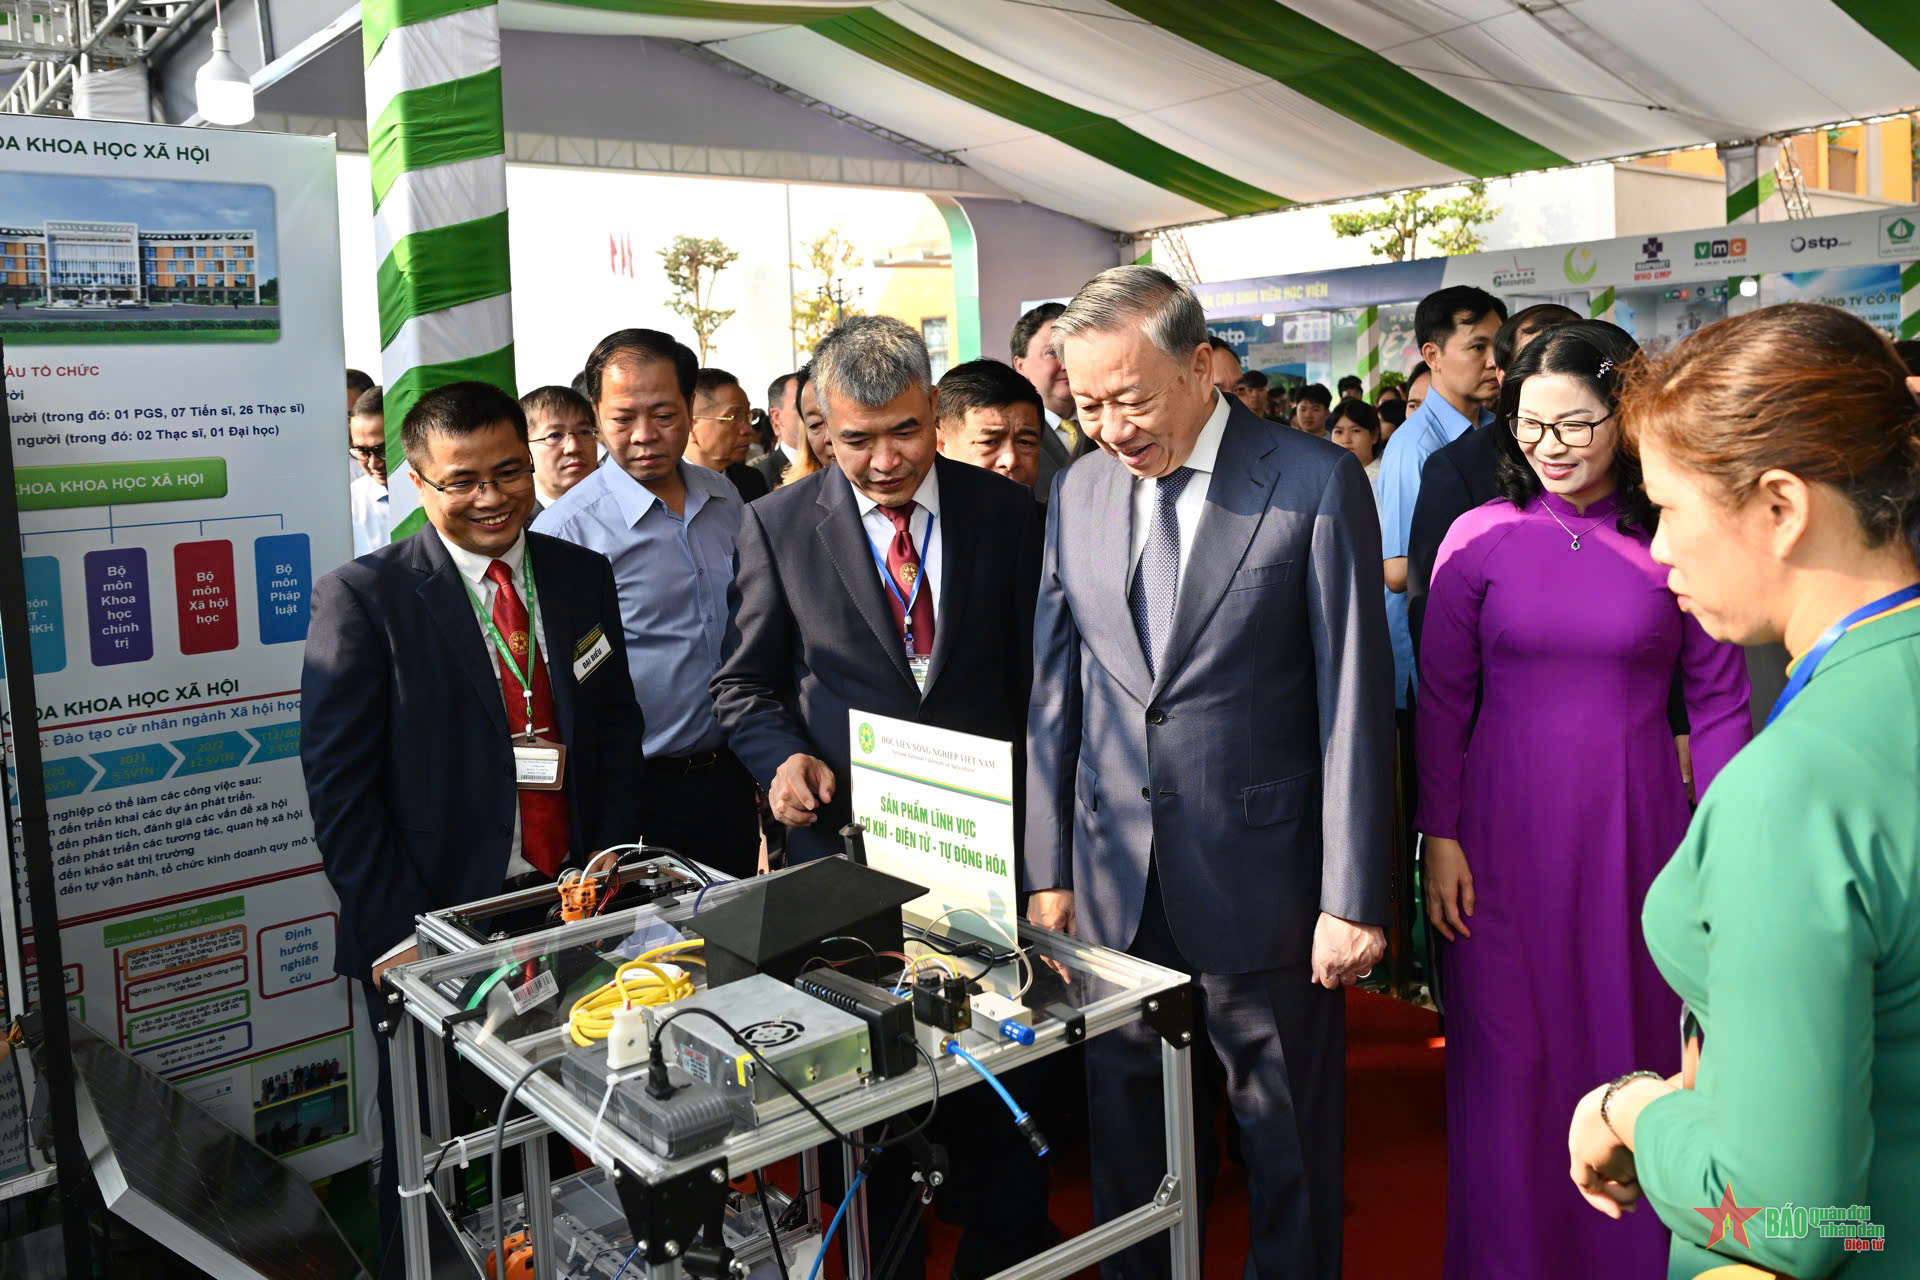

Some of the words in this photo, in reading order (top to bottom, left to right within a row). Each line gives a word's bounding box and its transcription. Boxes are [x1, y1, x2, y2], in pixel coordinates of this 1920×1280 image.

[26, 136, 87, 155] KHOA
[93, 141, 137, 160] HỌC
[143, 142, 170, 159] XÃ
[176, 146, 209, 164] HỘI
[1697, 240, 1744, 257] vmc
[1807, 236, 1838, 250] stp
[1633, 272, 1652, 281] WHO
[1654, 271, 1672, 279] GMP
[1849, 296, 1862, 305] TY
[1217, 328, 1245, 346] stp
[56, 363, 100, 377] CHỨC
[42, 412, 83, 424] (trong
[88, 410, 110, 420] đó:
[114, 410, 129, 420] 01
[134, 407, 167, 420] PGS,
[171, 407, 186, 417] 07
[189, 403, 217, 417] Tiến
[221, 405, 236, 416] sĩ,
[239, 405, 254, 415] 26
[257, 404, 286, 416] Thạc
[290, 403, 305, 415] sĩ)
[17, 433, 60, 448] người
[65, 432, 106, 445] (trong
[111, 431, 132, 442] đó:
[136, 430, 152, 441] 02
[156, 429, 188, 441] Thạc
[192, 428, 207, 439] sĩ,
[210, 427, 224, 437] 01
[229, 425, 249, 438] Đại
[252, 424, 280, 437] học)
[60, 479, 108, 493] KHOA
[112, 476, 147, 492] HỌC
[151, 473, 173, 487] XÃ
[177, 471, 205, 488] HỘI
[107, 565, 126, 578] Bộ
[275, 563, 293, 575] Bộ
[196, 570, 215, 583] Bộ
[271, 577, 298, 588] môn
[103, 580, 132, 592] môn
[192, 585, 220, 596] môn
[101, 595, 136, 606] Khoa
[270, 590, 301, 602] Pháp
[189, 600, 206, 610] Xã
[209, 597, 229, 610] hội
[275, 604, 298, 616] luật
[107, 609, 132, 621] học
[196, 614, 220, 625] học
[102, 622, 139, 635] chính
[114, 637, 129, 650] trị
[64, 694, 123, 720] KHOA
[127, 687, 170, 710] HỌC
[175, 682, 202, 701] XÃ
[207, 678, 239, 698] HỘI
[53, 731, 84, 746] Đào
[88, 728, 112, 742] tạo
[117, 722, 138, 735] cử
[141, 717, 178, 733] nhân
[182, 709, 226, 729] ngành
[230, 705, 249, 718] Xã
[252, 702, 274, 716] hội
[53, 806, 94, 822] nghiệp
[97, 801, 113, 813] có
[115, 796, 134, 810] thể
[136, 795, 158, 806] làm
[161, 791, 181, 801] các
[183, 786, 211, 797] công
[214, 779, 236, 791] việc
[239, 776, 262, 787] sau:
[59, 823, 81, 835] đến
[84, 817, 112, 830] triển
[115, 812, 139, 825] khai
[142, 808, 162, 820] các
[165, 806, 182, 819] dự
[184, 802, 198, 812] án
[201, 796, 225, 810] phát
[228, 791, 255, 803] triển.
[881, 792, 898, 816] SẢN
[901, 799, 928, 825] PHẨM
[931, 808, 953, 832] LĨNH
[956, 816, 976, 840] VỰC
[57, 837, 79, 850] đến
[83, 833, 112, 848] phân
[115, 828, 141, 839] tích,
[144, 821, 172, 834] đánh
[175, 816, 192, 829] giá
[195, 813, 215, 824] các
[217, 808, 237, 819] vấn
[240, 803, 253, 815] đề
[256, 803, 268, 812] xã
[271, 798, 288, 810] hội
[57, 852, 80, 866] đến
[84, 848, 110, 863] phát
[113, 842, 140, 855] triển
[142, 838, 162, 849] các
[166, 830, 201, 845] tương
[203, 826, 223, 838] tác,
[226, 820, 253, 834] quan
[256, 816, 269, 826] hệ
[271, 812, 284, 823] xã
[286, 809, 303, 821] hội
[895, 826, 916, 850] ĐIỆN
[919, 831, 931, 853] TỬ
[939, 840, 952, 863] TỰ
[954, 843, 982, 869] ĐỘNG
[985, 853, 1008, 877] HÓA
[58, 867, 81, 881] đến
[84, 861, 113, 875] khảo
[116, 857, 134, 869] sát
[137, 854, 152, 865] thị
[155, 847, 194, 861] trường
[59, 882, 82, 896] đến
[85, 880, 99, 892] tự
[102, 874, 123, 887] vận
[126, 868, 158, 882] hành,
[161, 862, 173, 875] tổ
[176, 857, 204, 872] chức
[207, 853, 231, 865] kinh
[233, 845, 267, 859] doanh
[269, 841, 288, 853] quy
[291, 836, 308, 847] mô
[285, 926, 312, 941] Định
[280, 941, 319, 957] hướng
[280, 955, 319, 972] nghiên
[289, 971, 311, 984] cứu
